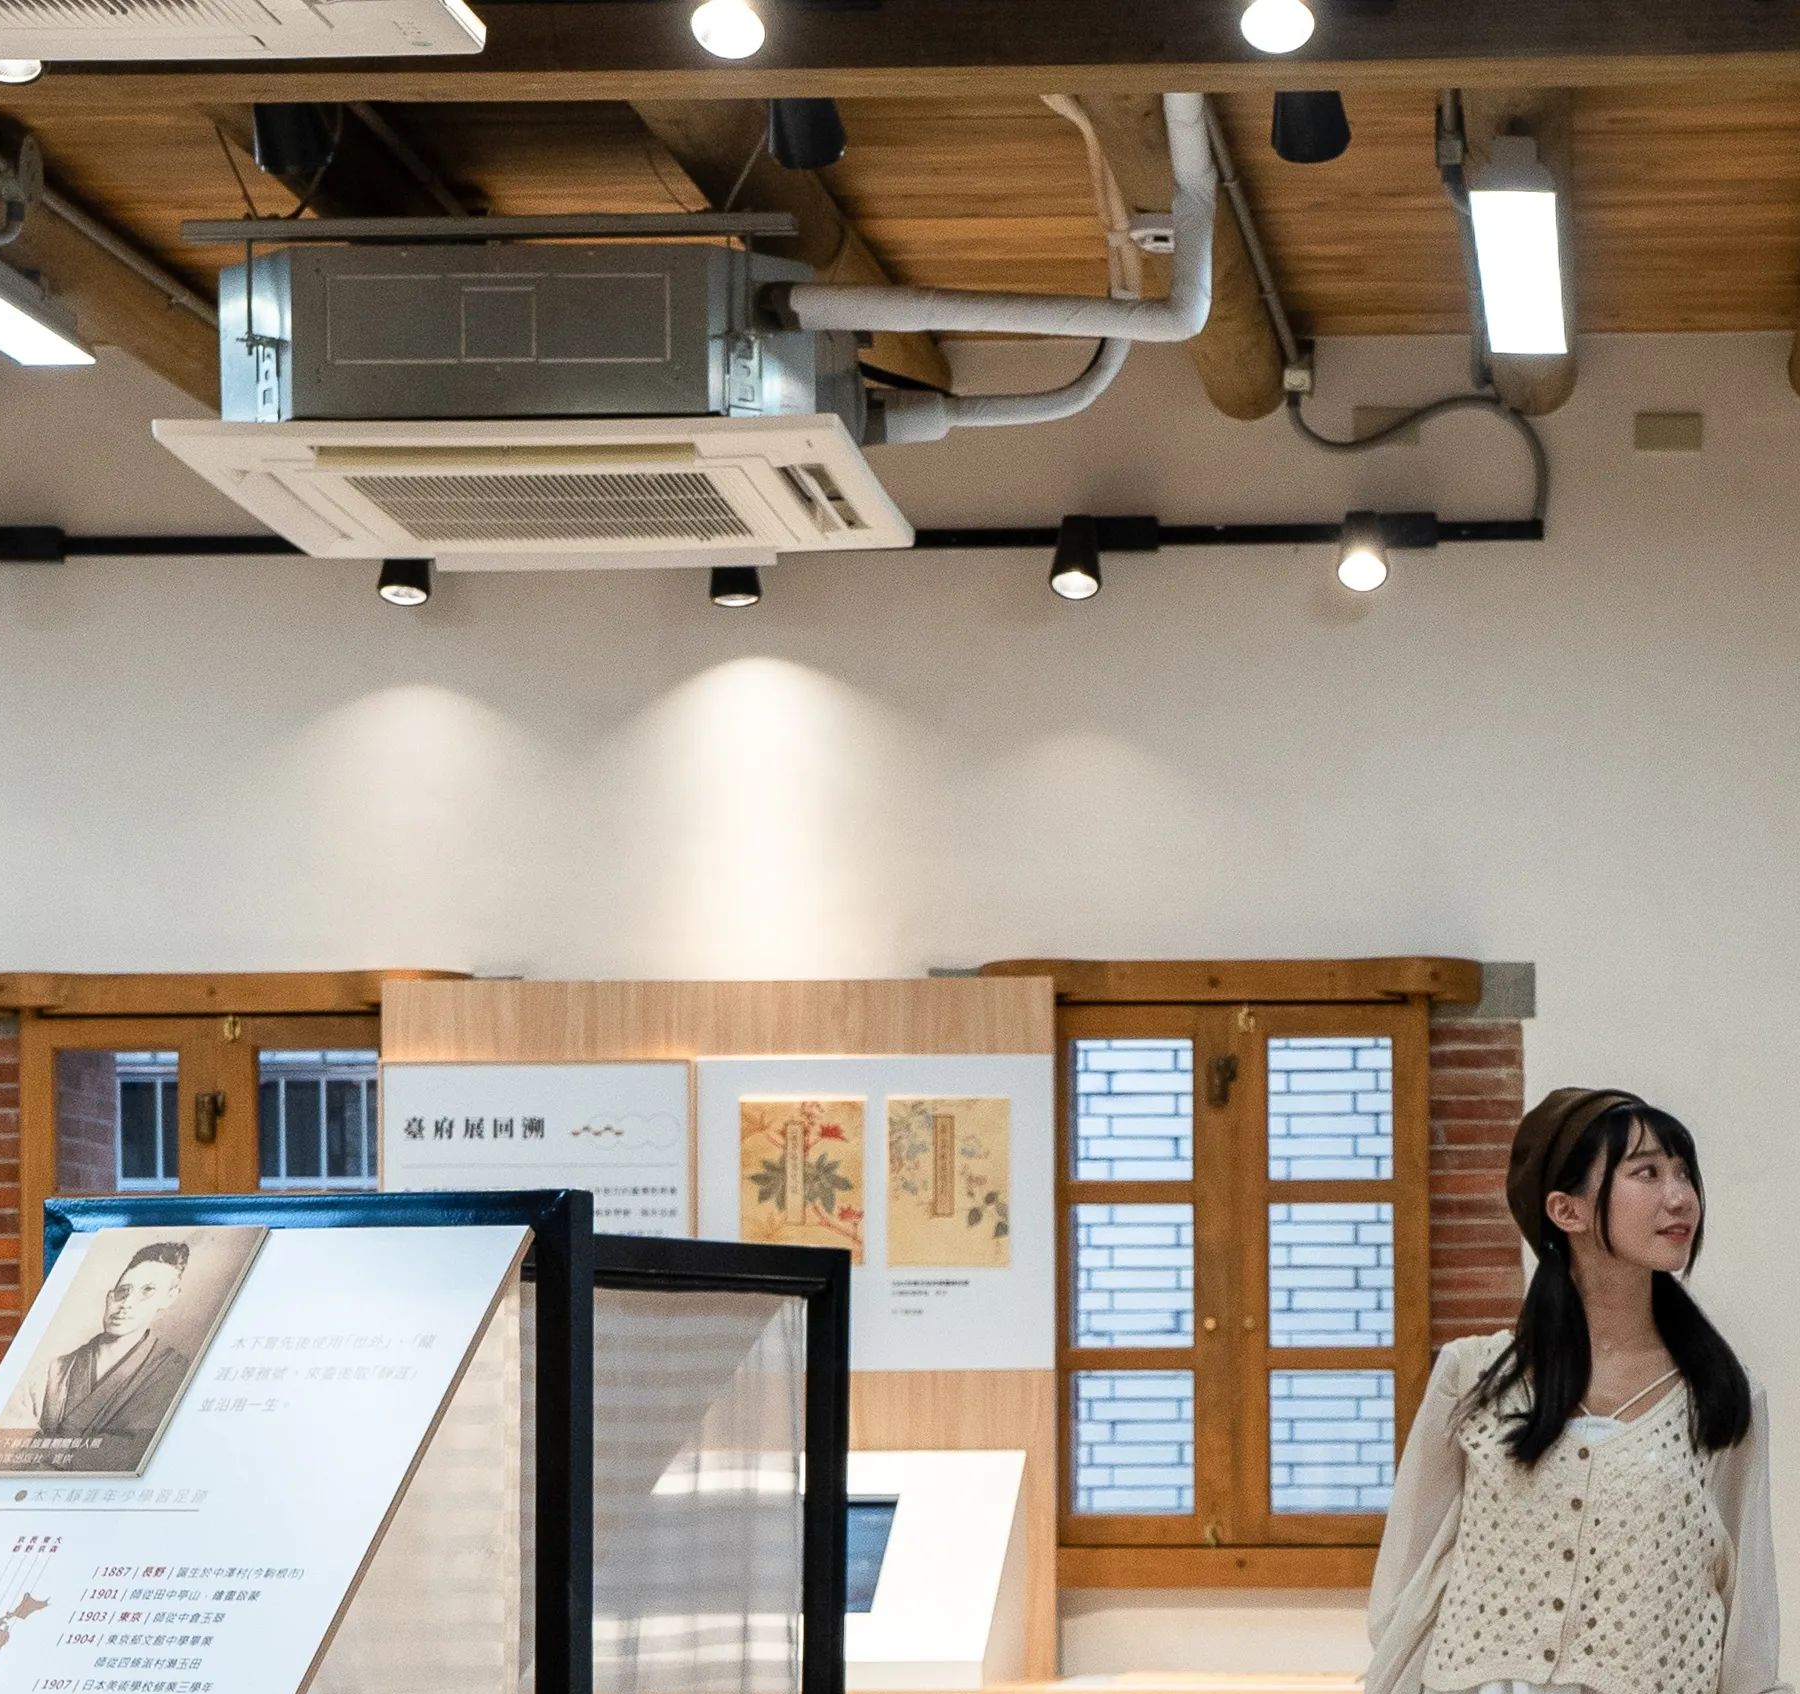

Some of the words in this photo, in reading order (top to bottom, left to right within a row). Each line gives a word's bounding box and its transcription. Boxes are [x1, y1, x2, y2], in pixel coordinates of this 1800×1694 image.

[403, 1115, 546, 1141] 臺府展回溯
[100, 1566, 132, 1578] 1887
[141, 1566, 167, 1579] 長野
[89, 1588, 119, 1600] 1901
[78, 1611, 108, 1623] 1903
[117, 1611, 142, 1623] 東京
[65, 1634, 96, 1645] 1904
[41, 1679, 73, 1691] 1907
